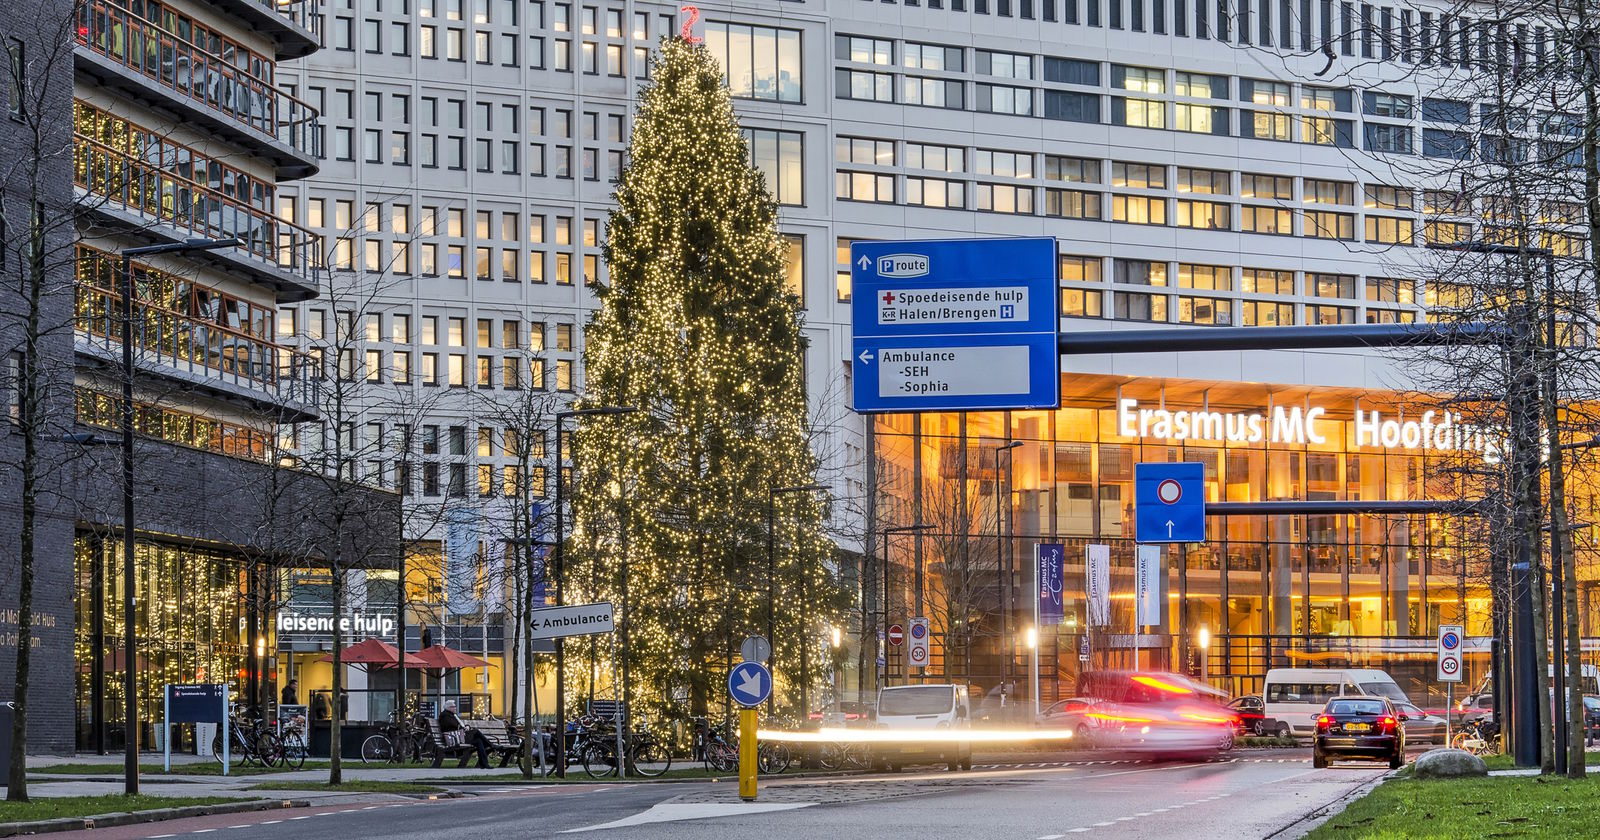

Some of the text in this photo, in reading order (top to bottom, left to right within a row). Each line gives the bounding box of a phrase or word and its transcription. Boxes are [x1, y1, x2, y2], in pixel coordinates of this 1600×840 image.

[896, 260, 926, 271] route
[899, 290, 1023, 306] Spoedeisende hulp
[899, 307, 997, 320] Halen/Brengen
[1002, 306, 1012, 317] H
[883, 351, 955, 362] Ambulance
[899, 366, 929, 377] -SEH
[899, 380, 949, 395] -Sophia
[1120, 398, 1263, 442] Erasmus
[1271, 405, 1326, 444] MC
[1041, 556, 1048, 569] MC
[1140, 558, 1147, 568] MC
[42, 612, 56, 627] Huis
[355, 613, 392, 637] hulp
[543, 614, 610, 628] Ambulance
[914, 650, 924, 658] 30
[1444, 661, 1456, 670] 30
